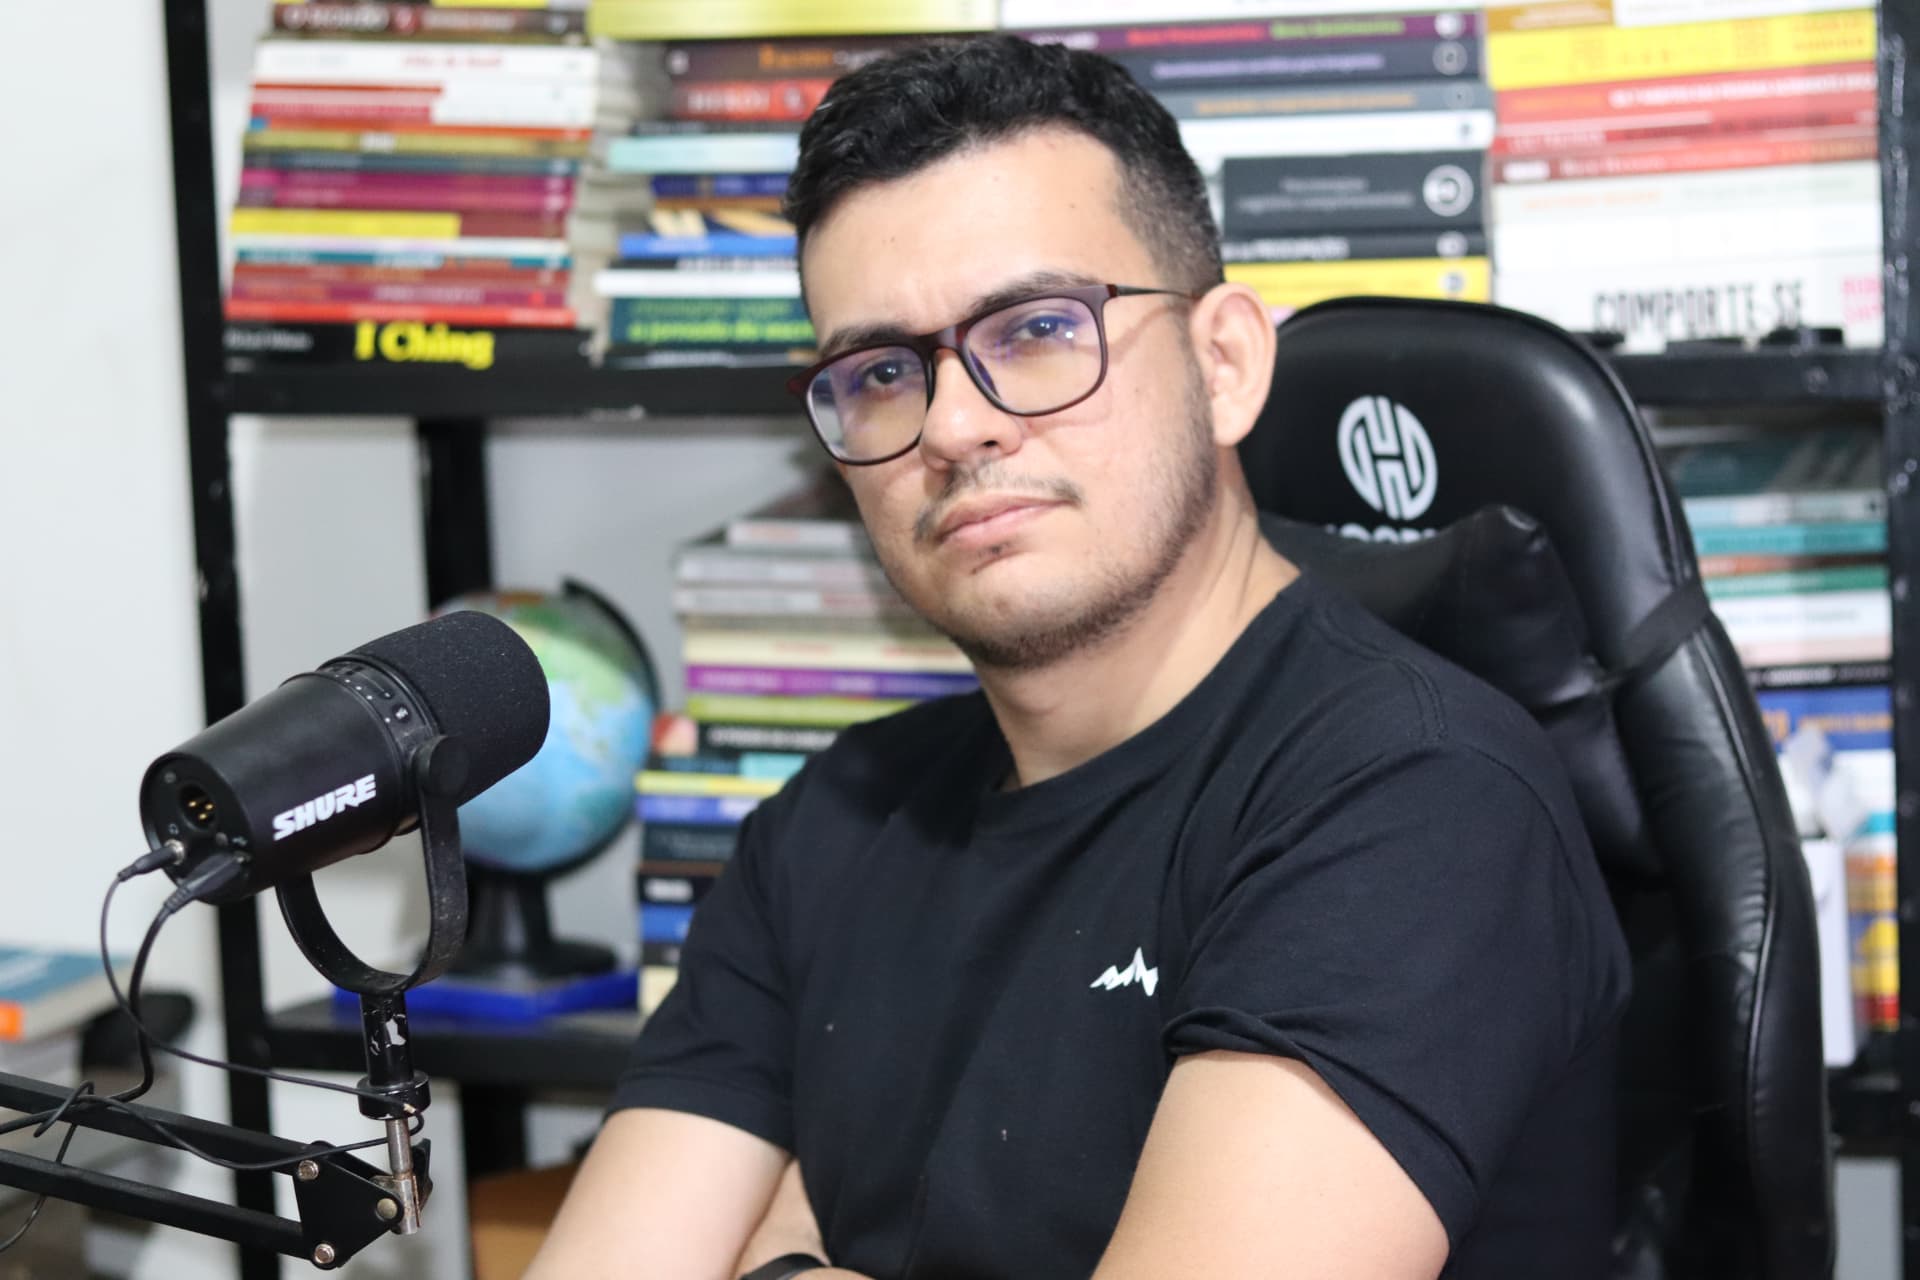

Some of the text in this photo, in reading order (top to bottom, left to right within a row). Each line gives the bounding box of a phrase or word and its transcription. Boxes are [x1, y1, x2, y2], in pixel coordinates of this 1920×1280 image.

[355, 321, 376, 361] I
[379, 323, 494, 370] Ching
[273, 773, 377, 841] SHURE
